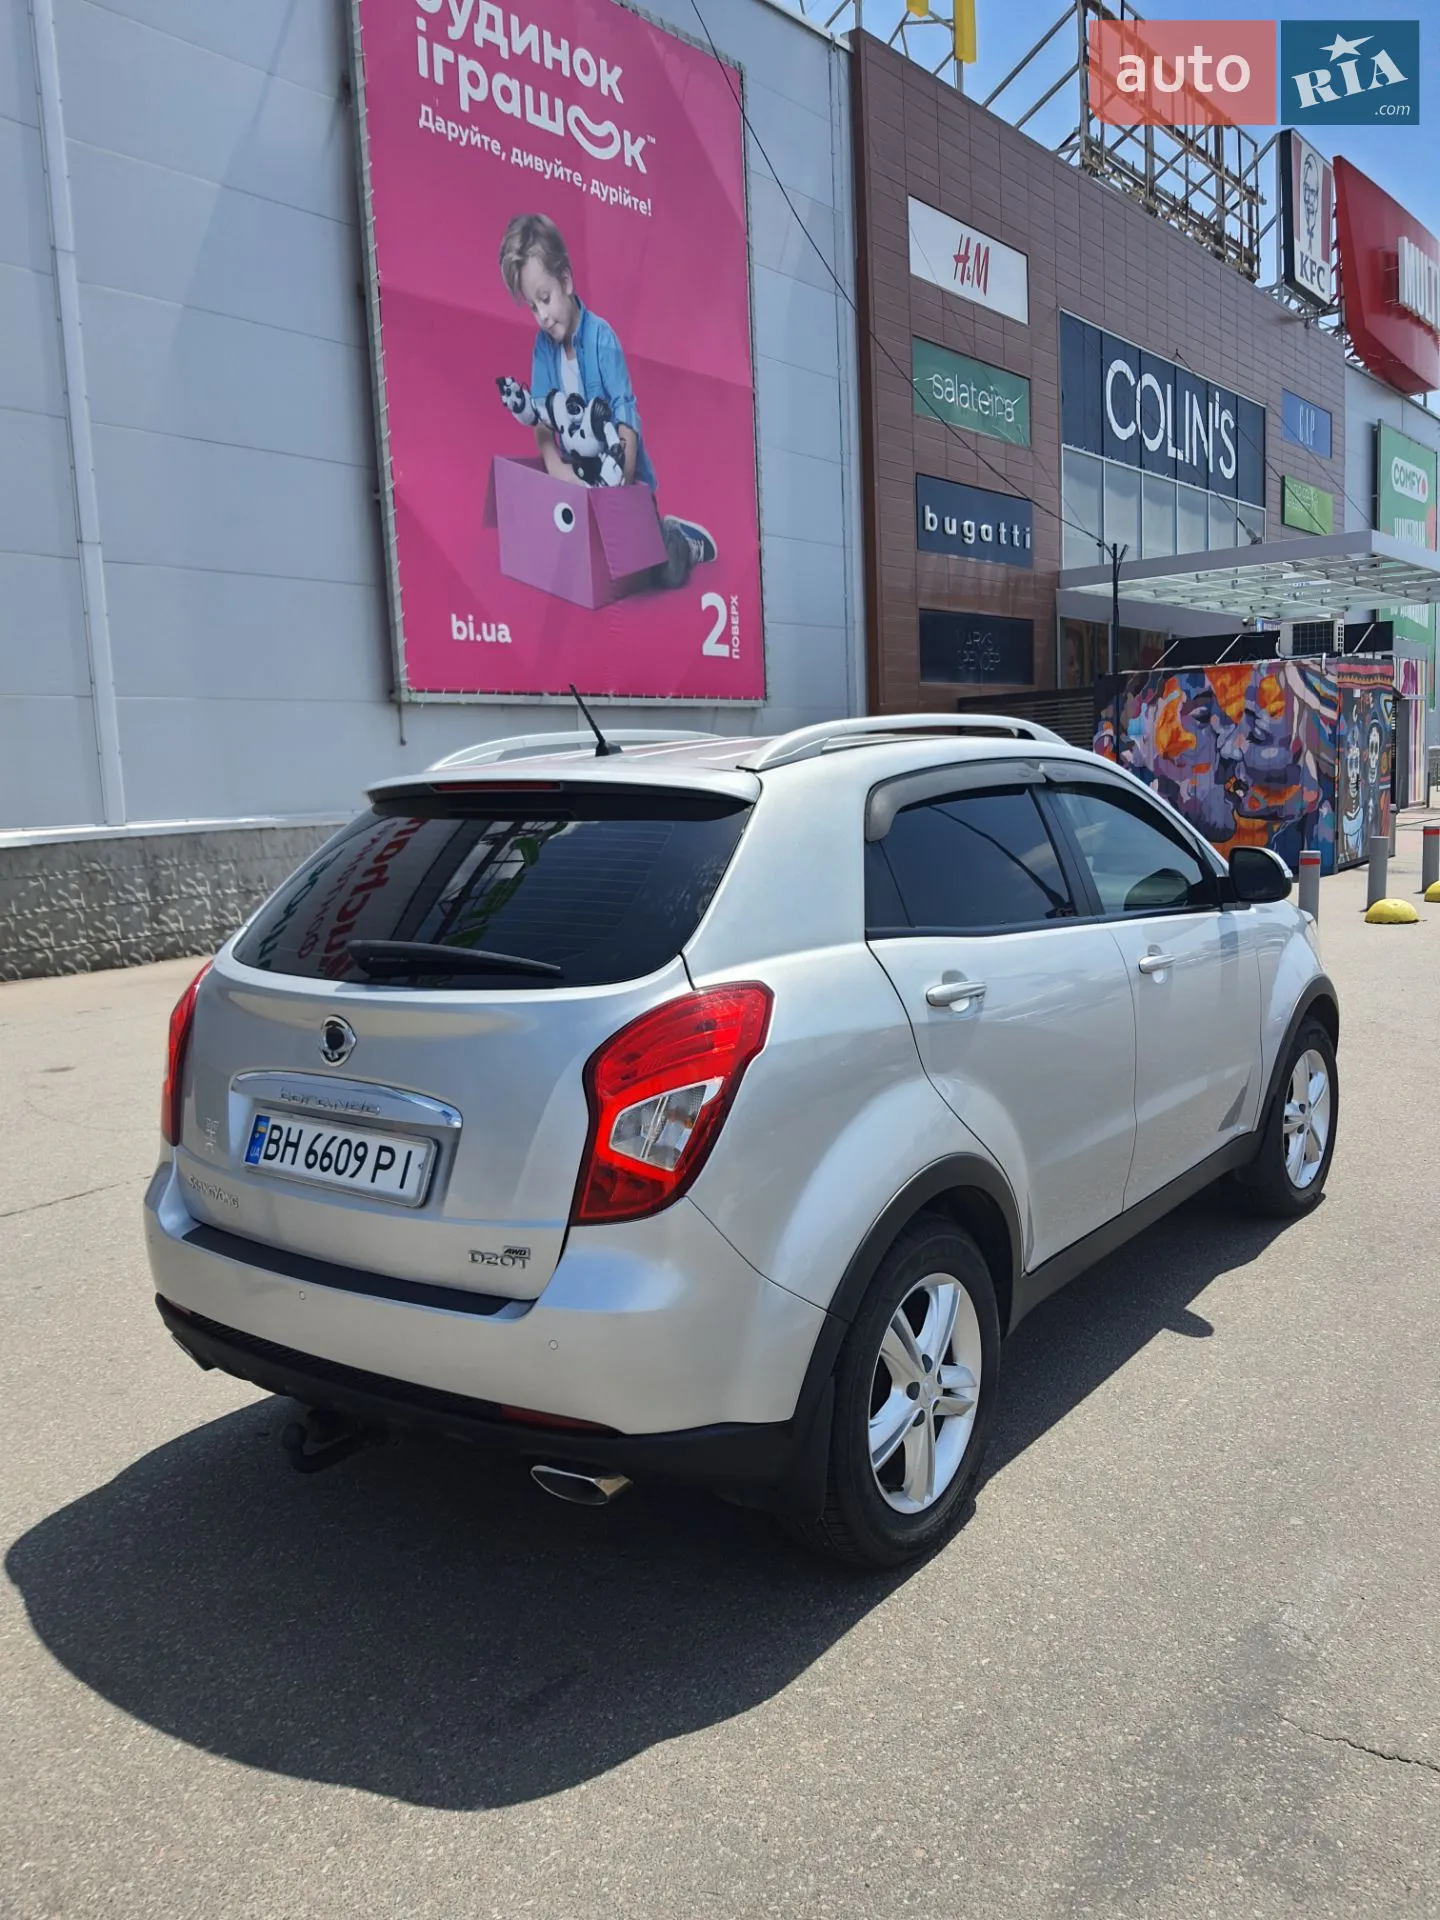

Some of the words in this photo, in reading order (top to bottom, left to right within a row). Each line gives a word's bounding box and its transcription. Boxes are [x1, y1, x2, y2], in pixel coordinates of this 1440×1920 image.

[418, 103, 506, 161] Даруйте,
[510, 147, 587, 191] дивуйте,
[590, 178, 652, 216] дурійте!
[953, 233, 990, 296] H&M
[1300, 251, 1326, 293] KFC
[1105, 359, 1236, 480] COLIN'S
[1393, 463, 1422, 496] COMFY
[924, 504, 1031, 550] bugatti
[451, 613, 513, 644] bi.ua
[701, 592, 730, 658] 2
[730, 595, 741, 660] ПОВЕРХ
[264, 1124, 303, 1166] BH
[304, 1133, 368, 1178] 6609
[370, 1145, 413, 1189] PI
[504, 1247, 527, 1256] AWD
